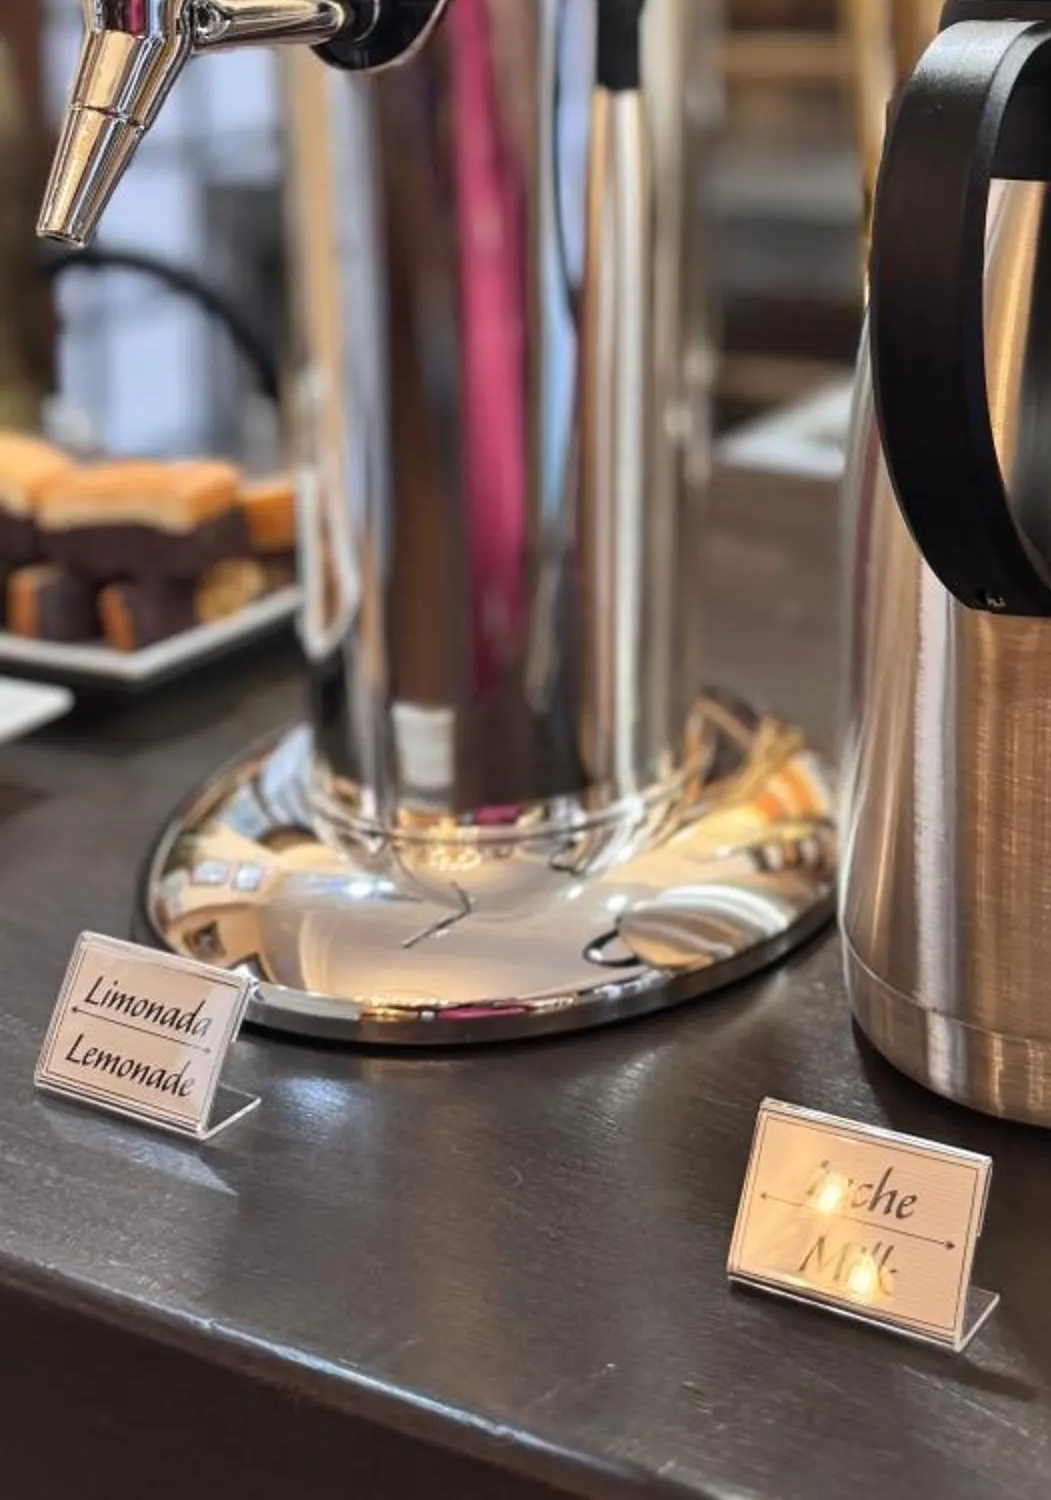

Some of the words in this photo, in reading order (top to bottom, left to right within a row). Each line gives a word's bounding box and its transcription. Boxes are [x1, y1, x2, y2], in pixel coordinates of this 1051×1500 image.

[84, 975, 213, 1038] Limonada
[65, 1032, 196, 1098] Lemonade
[806, 1160, 918, 1219] che
